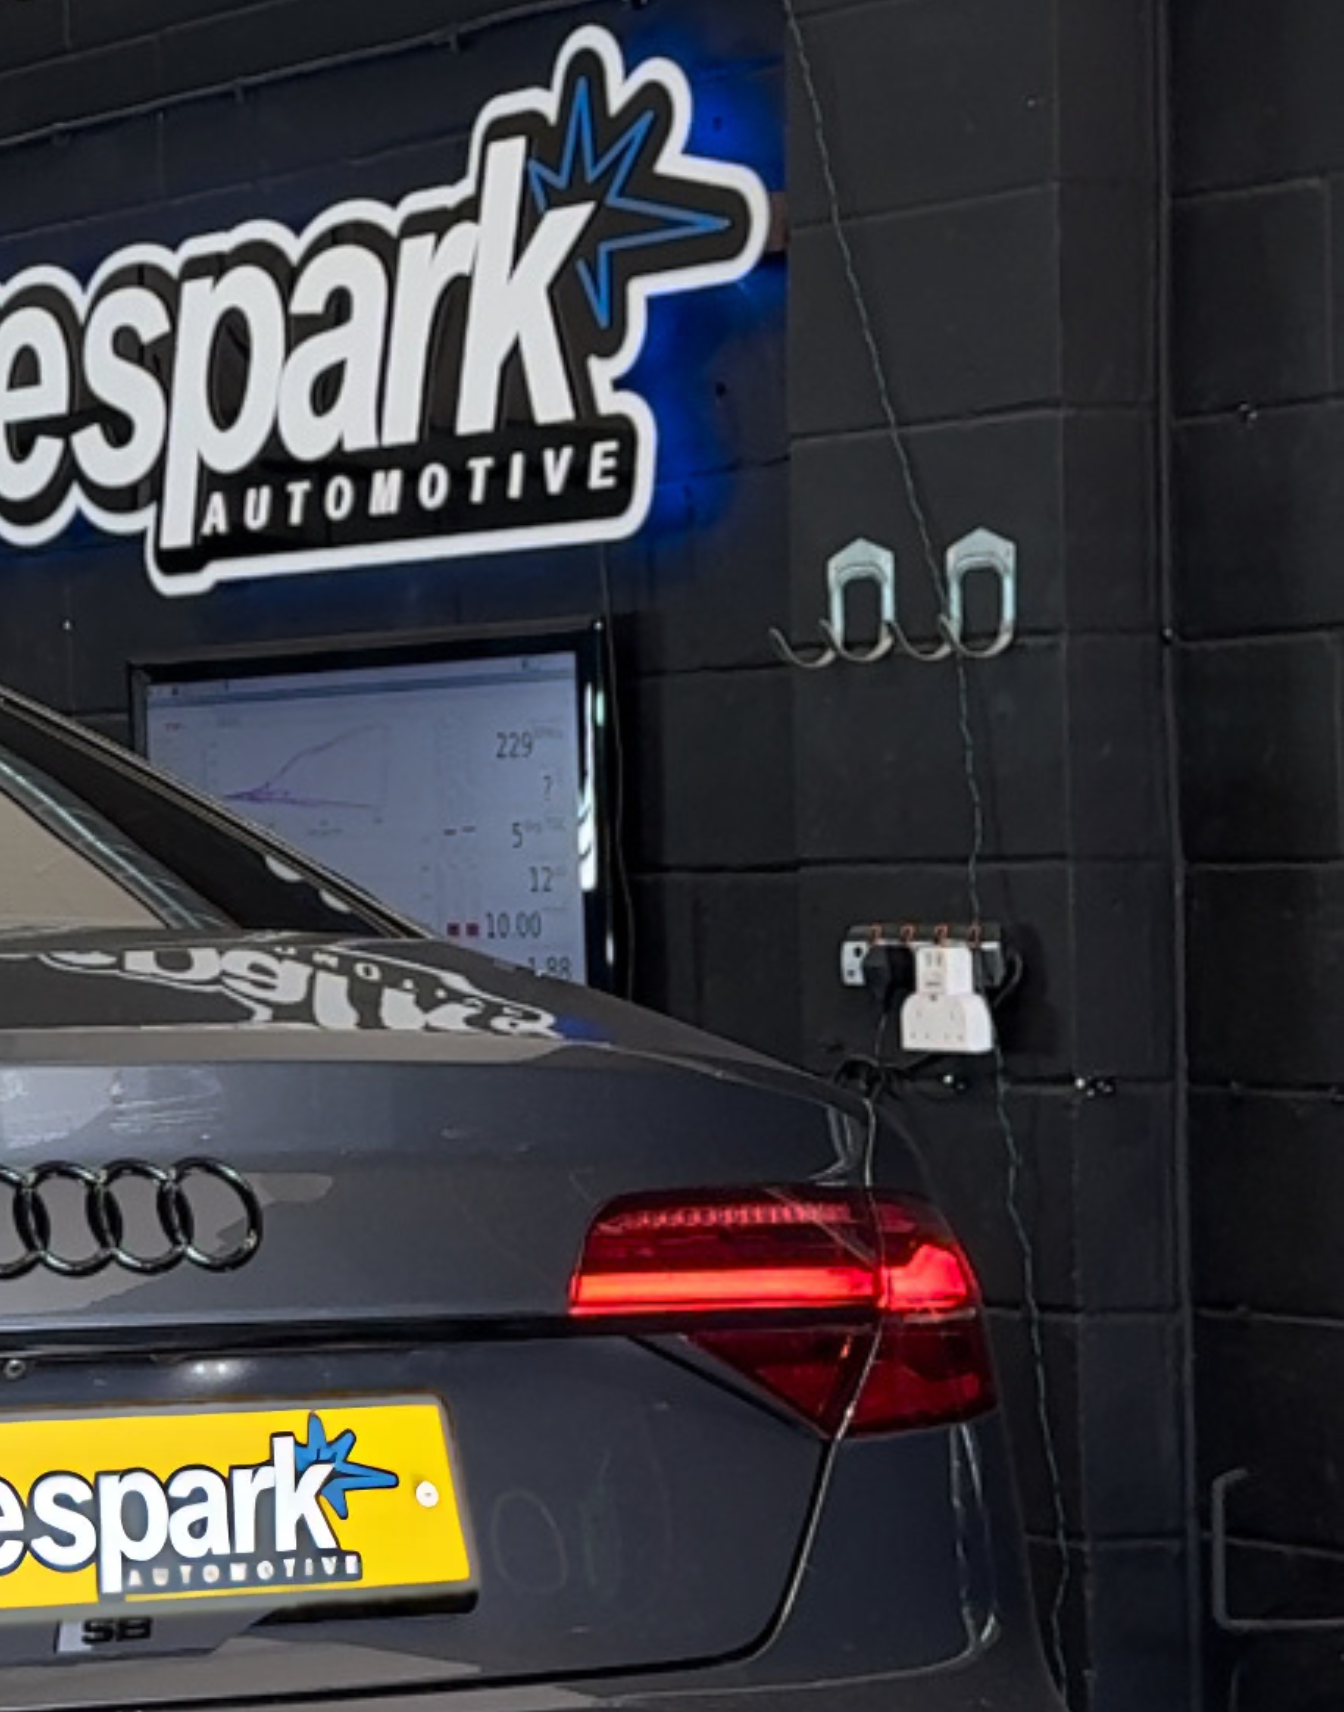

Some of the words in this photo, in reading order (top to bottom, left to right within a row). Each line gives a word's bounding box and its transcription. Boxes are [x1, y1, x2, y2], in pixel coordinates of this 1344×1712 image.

[201, 440, 621, 536] AUTOMOTIVE
[495, 731, 534, 759] 229
[511, 821, 523, 850] 5
[528, 865, 552, 894] 12
